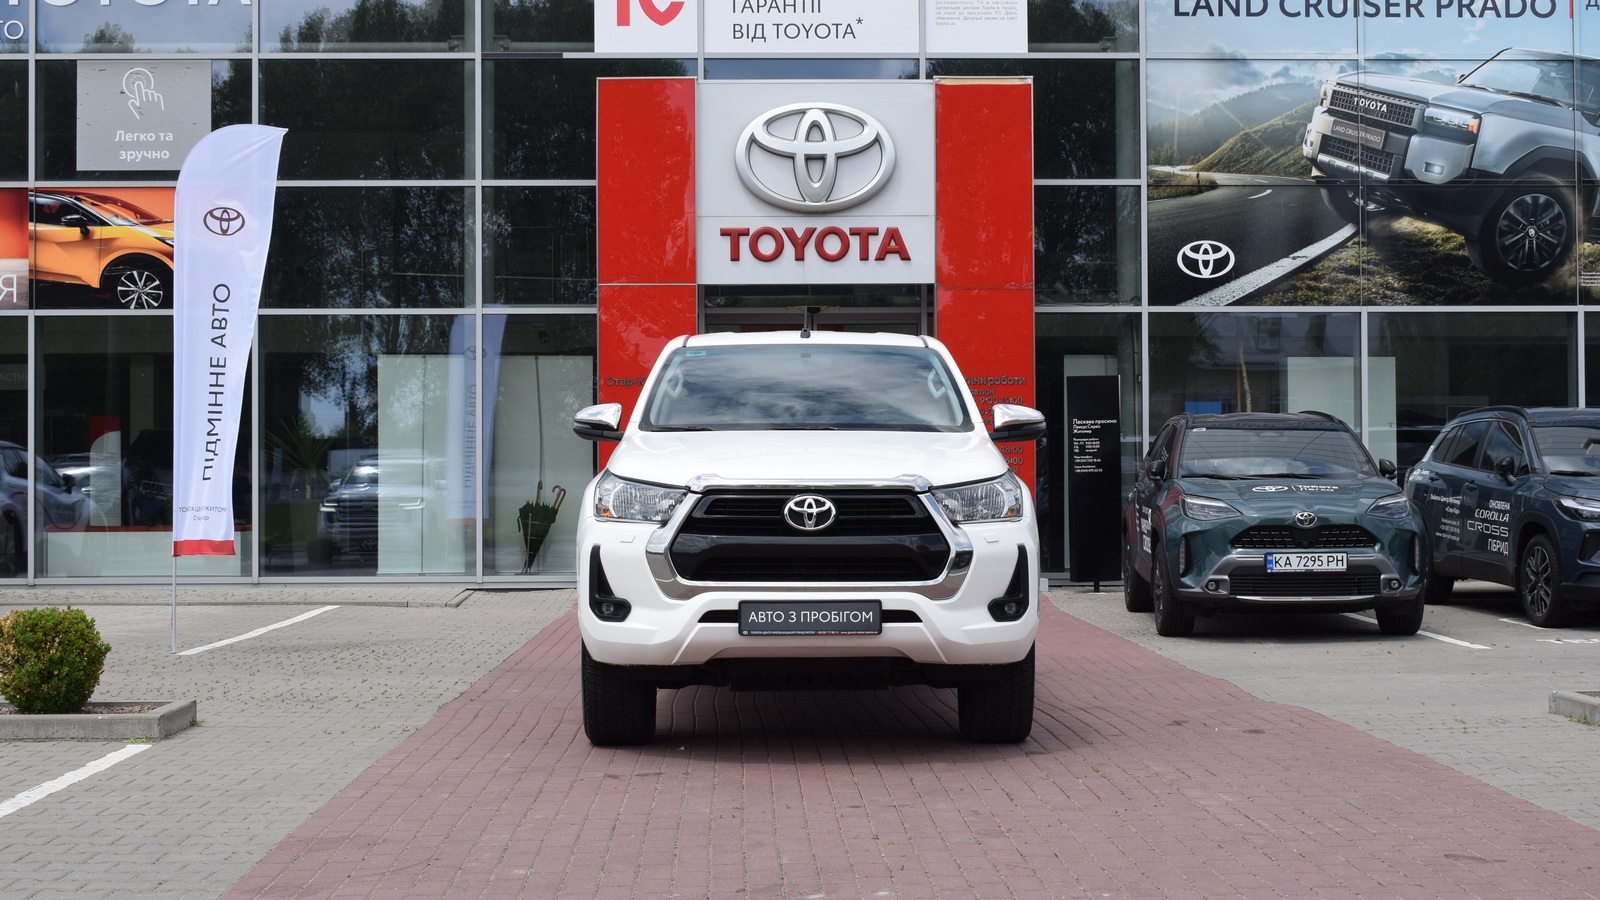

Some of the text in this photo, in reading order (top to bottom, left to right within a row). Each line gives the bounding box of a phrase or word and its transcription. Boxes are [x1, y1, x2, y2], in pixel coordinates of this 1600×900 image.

[1174, 0, 1557, 18] LAND CRUISER PRADO
[732, 24, 767, 43] ВІД
[1354, 97, 1387, 113] TOYOTA
[114, 130, 174, 142] Легко та
[1333, 124, 1381, 143] LAND CRUISER PRADO
[118, 150, 170, 162] зручно
[719, 226, 912, 262] TOYOTA
[202, 283, 232, 481] ПІДМІННЕ АВТО
[965, 375, 1026, 387] ини роботи
[1488, 499, 1511, 511] ОНОВЛЕНА
[1474, 508, 1510, 523] COROLLA
[1466, 520, 1509, 537] CROSS
[1296, 555, 1323, 567] 7295
[748, 611, 785, 623] АВТО
[800, 611, 873, 623] ПРОБІГОМ
